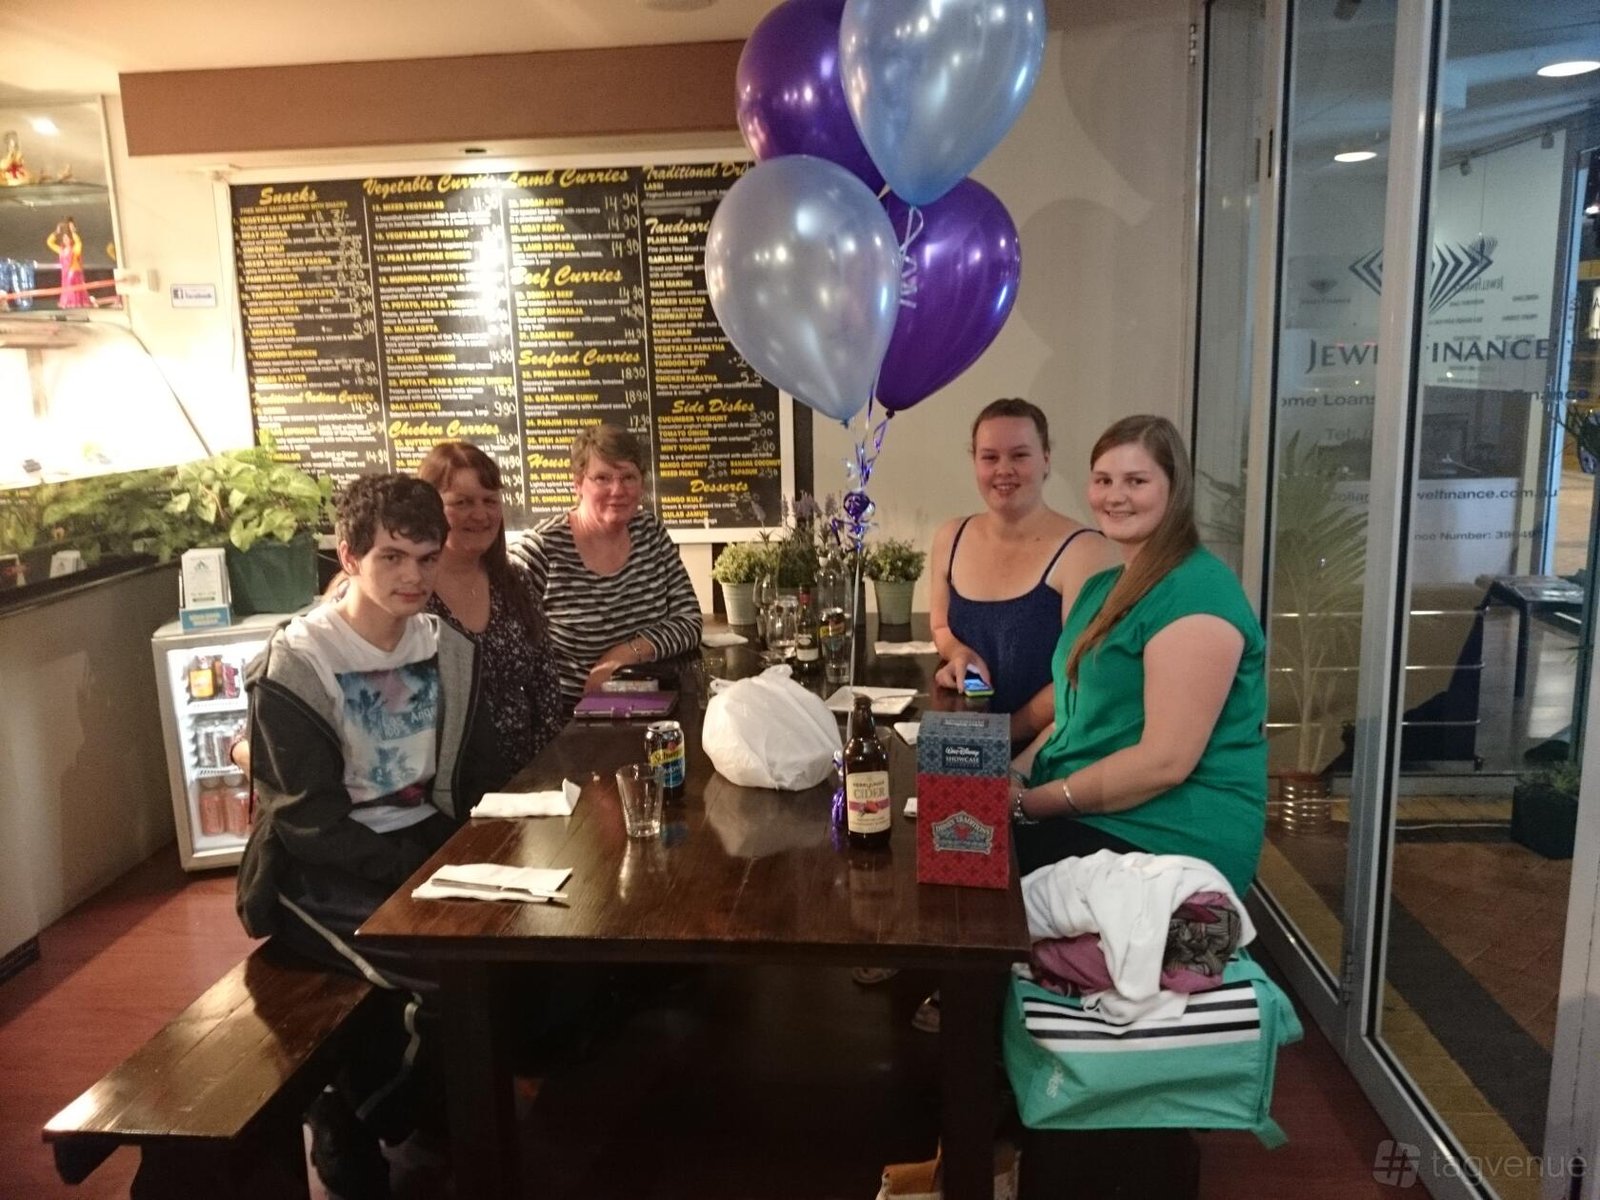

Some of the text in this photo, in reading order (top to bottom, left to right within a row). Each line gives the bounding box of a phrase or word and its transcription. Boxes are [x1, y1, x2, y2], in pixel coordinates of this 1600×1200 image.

[507, 168, 629, 188] Lamb Curries
[642, 162, 717, 180] Traditional
[259, 185, 317, 205] Snacks
[363, 177, 433, 199] Vegetable
[645, 218, 710, 234] Tandoori
[509, 266, 551, 289] Beef
[554, 264, 623, 286] Curries
[518, 348, 641, 369] Seafood Curries
[672, 398, 755, 414] Side Dishes
[388, 420, 443, 439] Chicken
[446, 419, 500, 438] Curries
[527, 453, 571, 468] House
[690, 480, 748, 493] Desserts
[854, 787, 885, 799] CIDER
